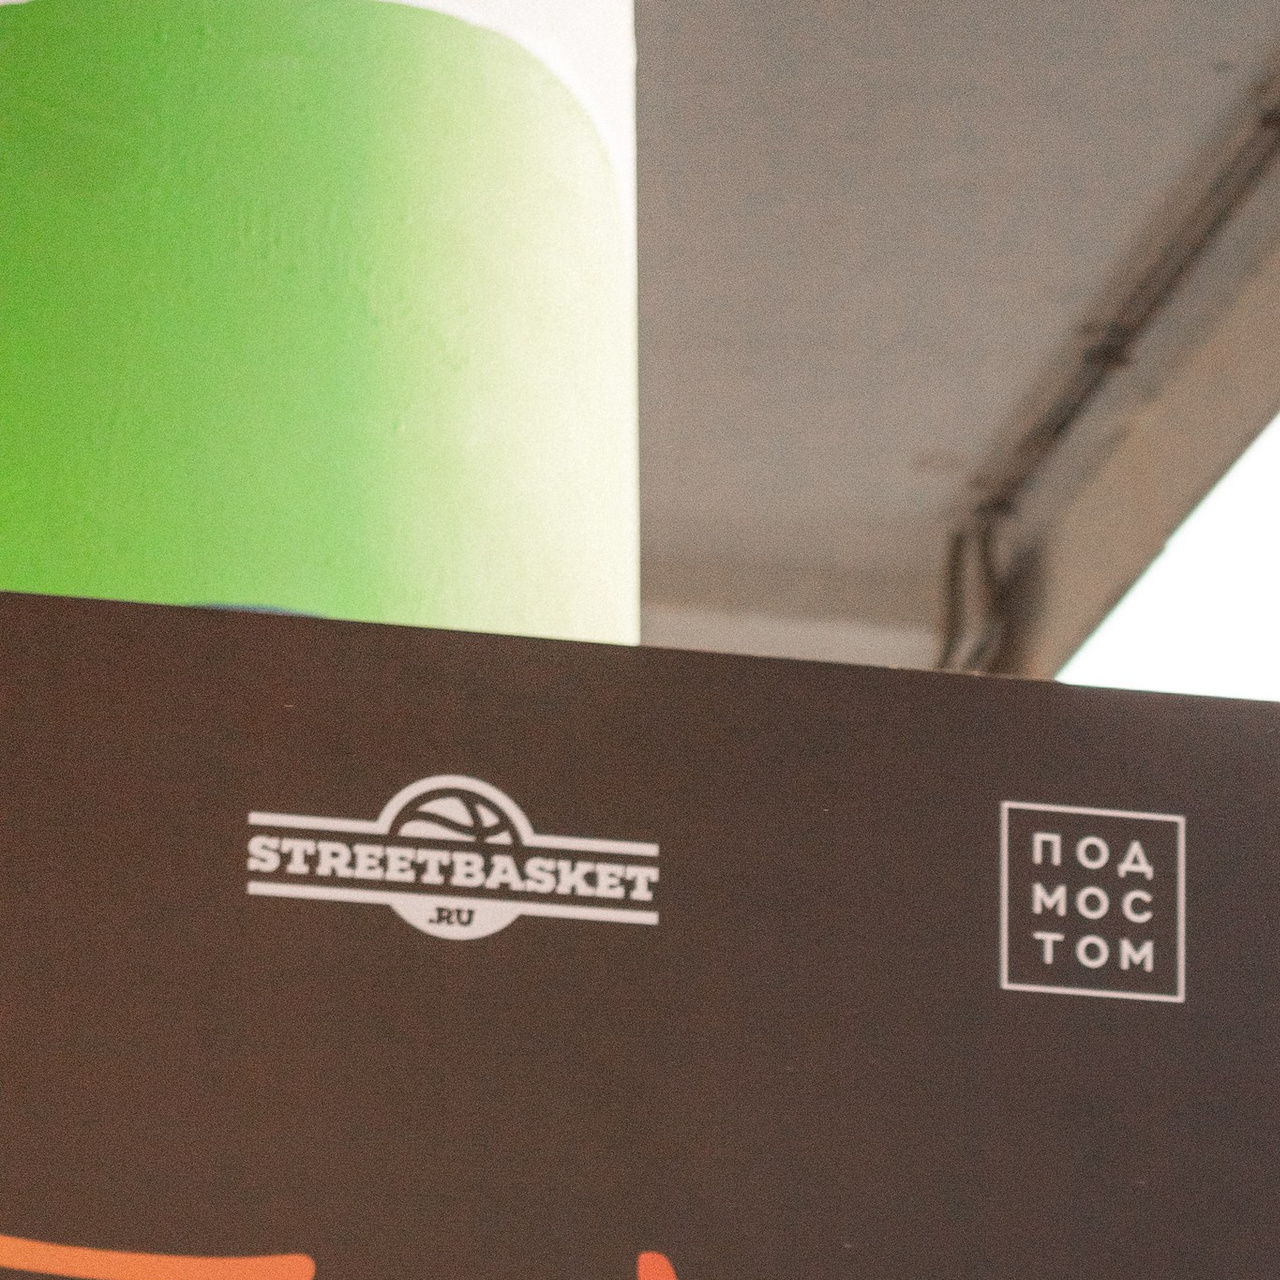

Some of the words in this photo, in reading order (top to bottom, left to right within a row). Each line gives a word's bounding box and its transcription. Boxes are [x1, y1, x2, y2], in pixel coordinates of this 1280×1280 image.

[247, 834, 660, 901] STREETBASKET
[1032, 831, 1154, 881] ПОД
[429, 907, 475, 927] .RU
[1032, 881, 1154, 924] МОС
[1032, 930, 1154, 973] ТОМ
